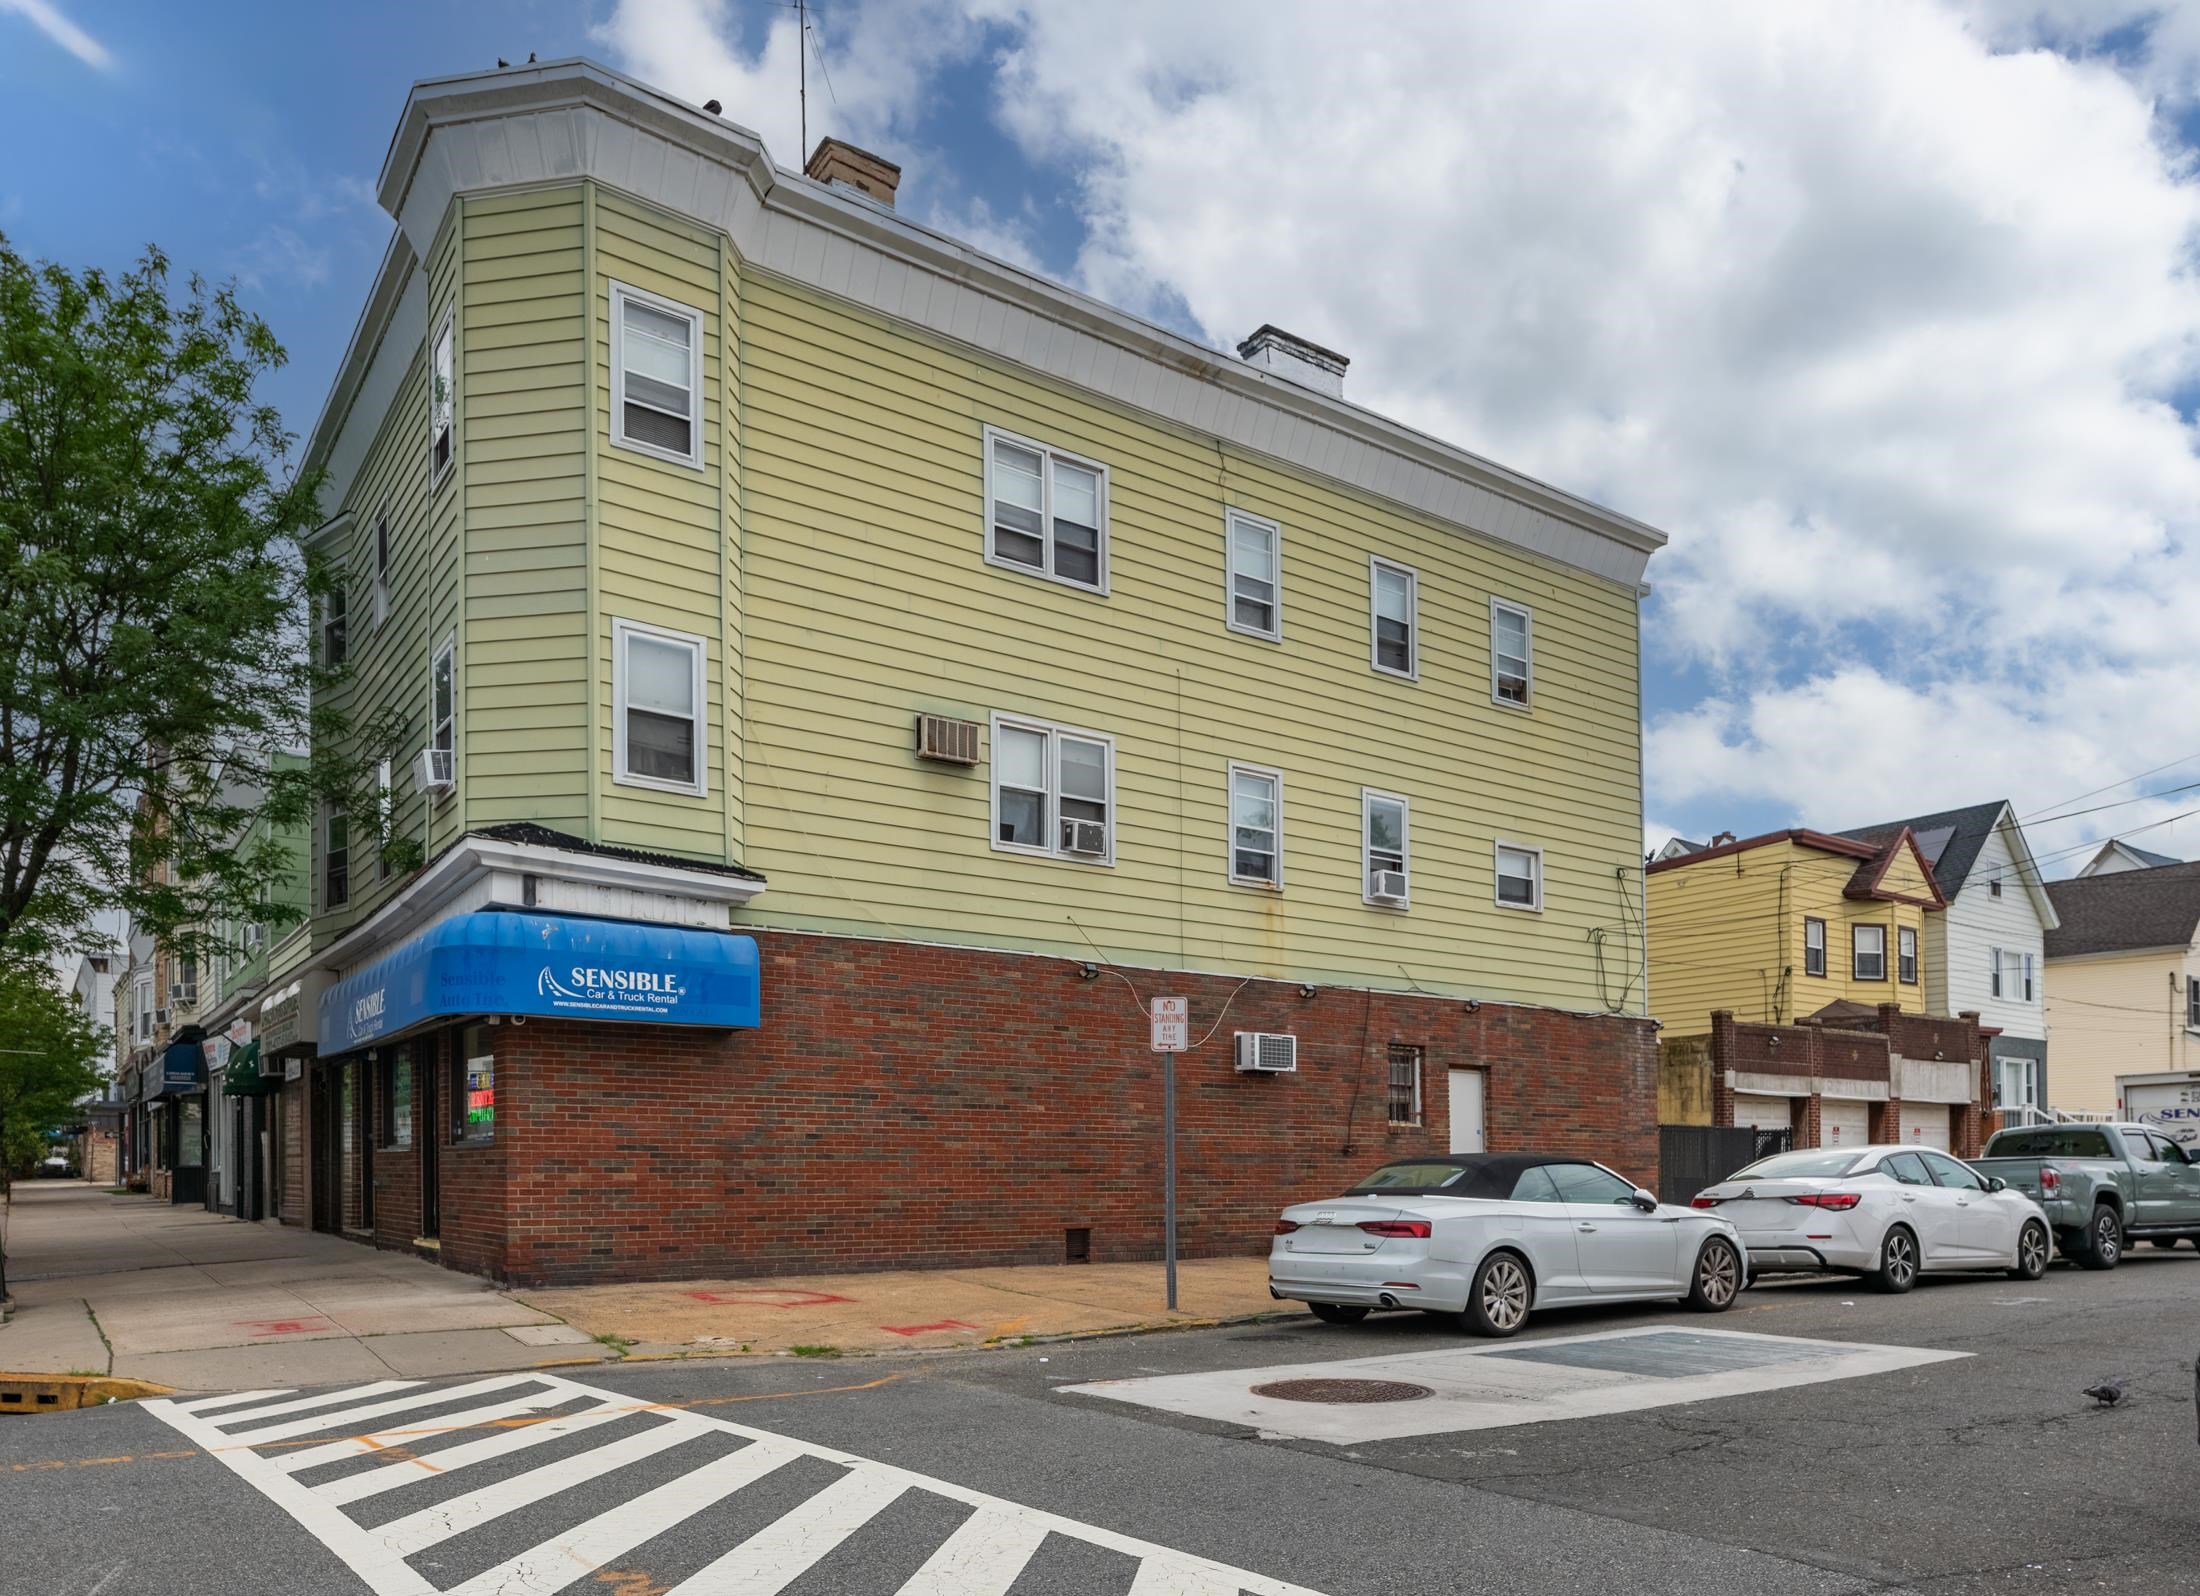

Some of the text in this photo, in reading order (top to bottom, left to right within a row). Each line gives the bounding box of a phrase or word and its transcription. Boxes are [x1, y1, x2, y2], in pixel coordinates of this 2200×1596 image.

[571, 967, 678, 994] SENSIBLE
[586, 988, 678, 1004] Car & Truck Rental
[1163, 1001, 1175, 1011] NO
[1155, 1013, 1184, 1024] STANDING
